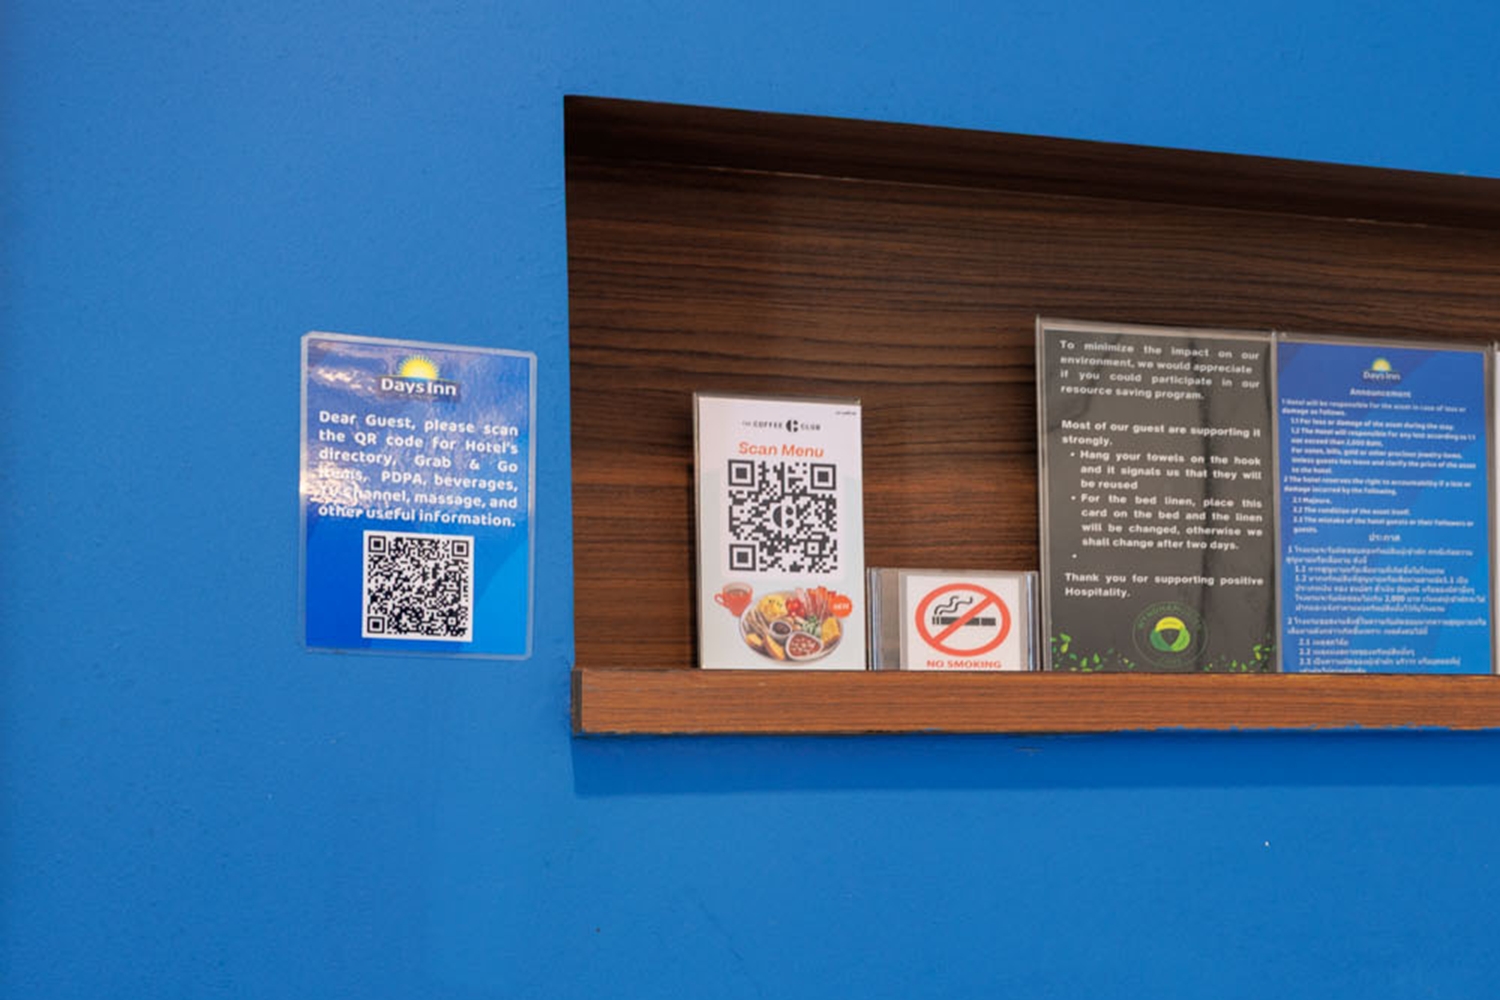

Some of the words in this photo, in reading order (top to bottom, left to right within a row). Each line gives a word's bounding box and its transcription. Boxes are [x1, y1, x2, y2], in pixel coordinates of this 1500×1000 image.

[1059, 339, 1075, 349] To
[1084, 342, 1134, 352] minimize
[1143, 345, 1162, 354] the
[1171, 347, 1209, 358] impact
[1060, 356, 1134, 368] environment,
[1156, 361, 1191, 371] would
[1193, 363, 1252, 373] appreciate
[1060, 369, 1068, 378] if
[1079, 371, 1100, 381] you
[1109, 373, 1141, 382] could
[1151, 375, 1212, 386] participate
[1221, 378, 1232, 386] in
[1241, 380, 1259, 388] our
[1362, 371, 1385, 380] Days
[1386, 372, 1400, 380] Inn
[381, 378, 424, 396] Days
[426, 380, 457, 398] Inn
[1060, 385, 1112, 395] resource
[1115, 388, 1152, 399] saving
[1154, 390, 1204, 400] program.
[319, 410, 356, 424] Dear
[365, 414, 415, 430] Guest,
[424, 418, 475, 433] please
[483, 424, 518, 436] scan
[753, 421, 783, 430] COFFEE
[800, 423, 821, 431] CLUB
[1061, 419, 1090, 430] Most
[1094, 422, 1106, 430] of
[1110, 423, 1129, 431] our
[1132, 424, 1164, 433] guest
[1168, 426, 1186, 434] are
[1190, 427, 1250, 438] supporting
[1253, 428, 1260, 437] it
[319, 429, 345, 442] the
[354, 431, 377, 446] QR
[386, 433, 423, 447] code
[431, 437, 457, 450] for
[465, 439, 518, 455] Hotel's
[1062, 435, 1112, 446] strongly.
[738, 441, 778, 456] Scan
[781, 443, 824, 458] Menu
[319, 447, 397, 467] directory,
[413, 454, 451, 469] Grab
[469, 458, 480, 470] &
[497, 459, 518, 472] Go
[1080, 450, 1109, 461] Hang
[1115, 453, 1140, 461] your
[1146, 452, 1184, 462] towels
[1190, 455, 1205, 464] on
[1209, 455, 1228, 464] the
[1234, 456, 1260, 465] hook
[1080, 465, 1101, 474] and
[1107, 465, 1115, 474] it
[1120, 466, 1161, 477] signals
[1185, 468, 1207, 478] that
[1212, 469, 1237, 480] they
[1242, 471, 1261, 479] will
[381, 470, 428, 486] PDPA,
[434, 473, 518, 492] beverages,
[1080, 479, 1095, 488] be
[1098, 481, 1137, 489] reused
[345, 486, 410, 505] channel,
[414, 493, 486, 509] massage,
[489, 496, 518, 509] and
[1080, 493, 1099, 502] For
[1108, 494, 1126, 503] the
[1134, 495, 1157, 504] bed
[1164, 496, 1196, 507] linen,
[1202, 497, 1234, 508] place
[1242, 499, 1262, 508] this
[318, 504, 363, 519] other
[366, 505, 415, 521] useful
[419, 507, 516, 527] information.
[1081, 508, 1107, 517] card
[1113, 510, 1127, 518] on
[1133, 510, 1152, 518] the
[1158, 510, 1179, 519] bed
[1185, 510, 1206, 521] and
[1211, 512, 1230, 521] the
[1235, 513, 1262, 521] linen
[1081, 523, 1102, 531] will
[1108, 523, 1122, 532] be
[1128, 524, 1180, 535] changed,
[1185, 525, 1241, 535] otherwise
[1082, 537, 1109, 546] shall
[1112, 538, 1154, 549] change
[1156, 539, 1183, 548] after
[1186, 540, 1207, 549] two
[1209, 540, 1238, 551] days.
[1064, 572, 1099, 581] Thank
[1105, 575, 1126, 584] you
[1132, 574, 1148, 583] for
[1154, 575, 1214, 586] supporting
[1220, 576, 1263, 586] positive
[1065, 587, 1130, 598] Hospitality.
[926, 660, 944, 668] NO
[947, 660, 1001, 668] SMOKING
